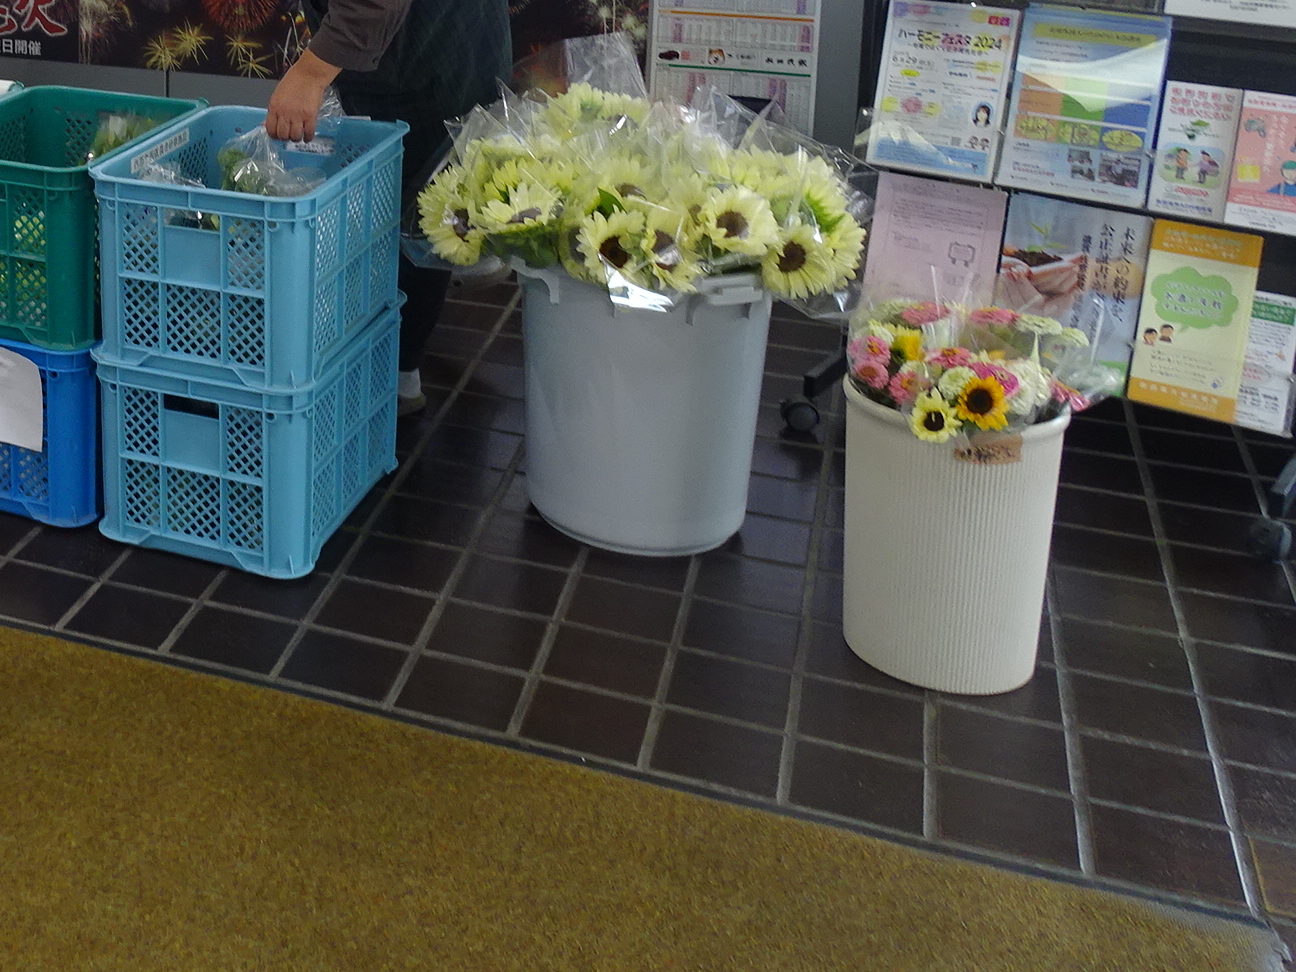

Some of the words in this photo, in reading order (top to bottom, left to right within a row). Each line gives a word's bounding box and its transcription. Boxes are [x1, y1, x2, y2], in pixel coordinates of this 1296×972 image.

[897, 28, 972, 47] ハーモニーフェスタ
[973, 35, 1003, 50] 2024
